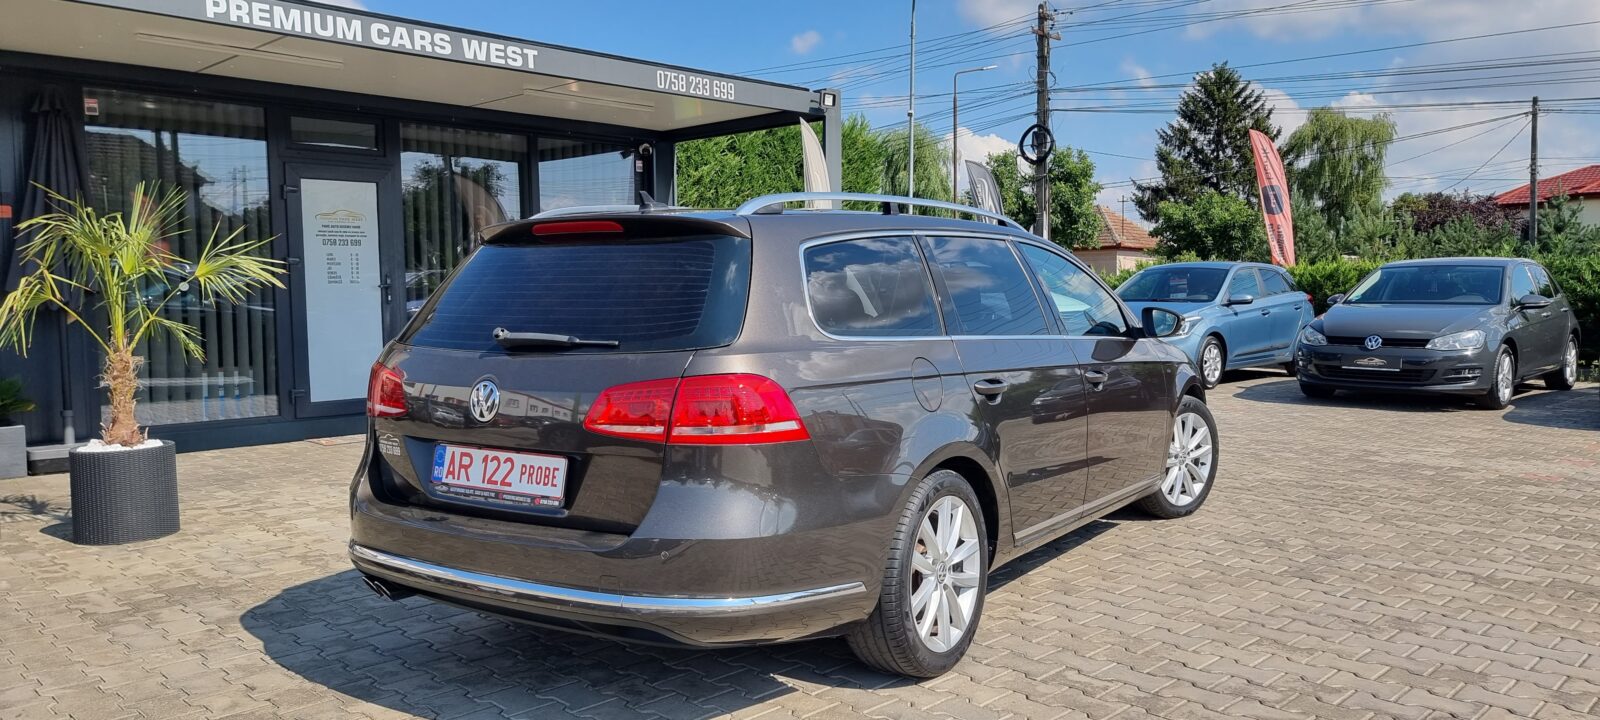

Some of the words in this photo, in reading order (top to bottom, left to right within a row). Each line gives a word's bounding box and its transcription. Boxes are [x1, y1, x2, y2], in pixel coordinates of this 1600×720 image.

[206, 0, 363, 42] PREMIUM
[370, 22, 452, 55] CARS
[461, 37, 539, 69] WEST
[656, 70, 686, 92] 0758
[689, 76, 710, 96] 233
[713, 80, 735, 100] 699
[322, 238, 337, 246] 0758
[338, 238, 349, 247] 233
[350, 239, 362, 247] 699
[433, 465, 443, 478] RO
[445, 450, 474, 482] AR
[482, 454, 515, 487] 122
[519, 463, 560, 488] PROBE
